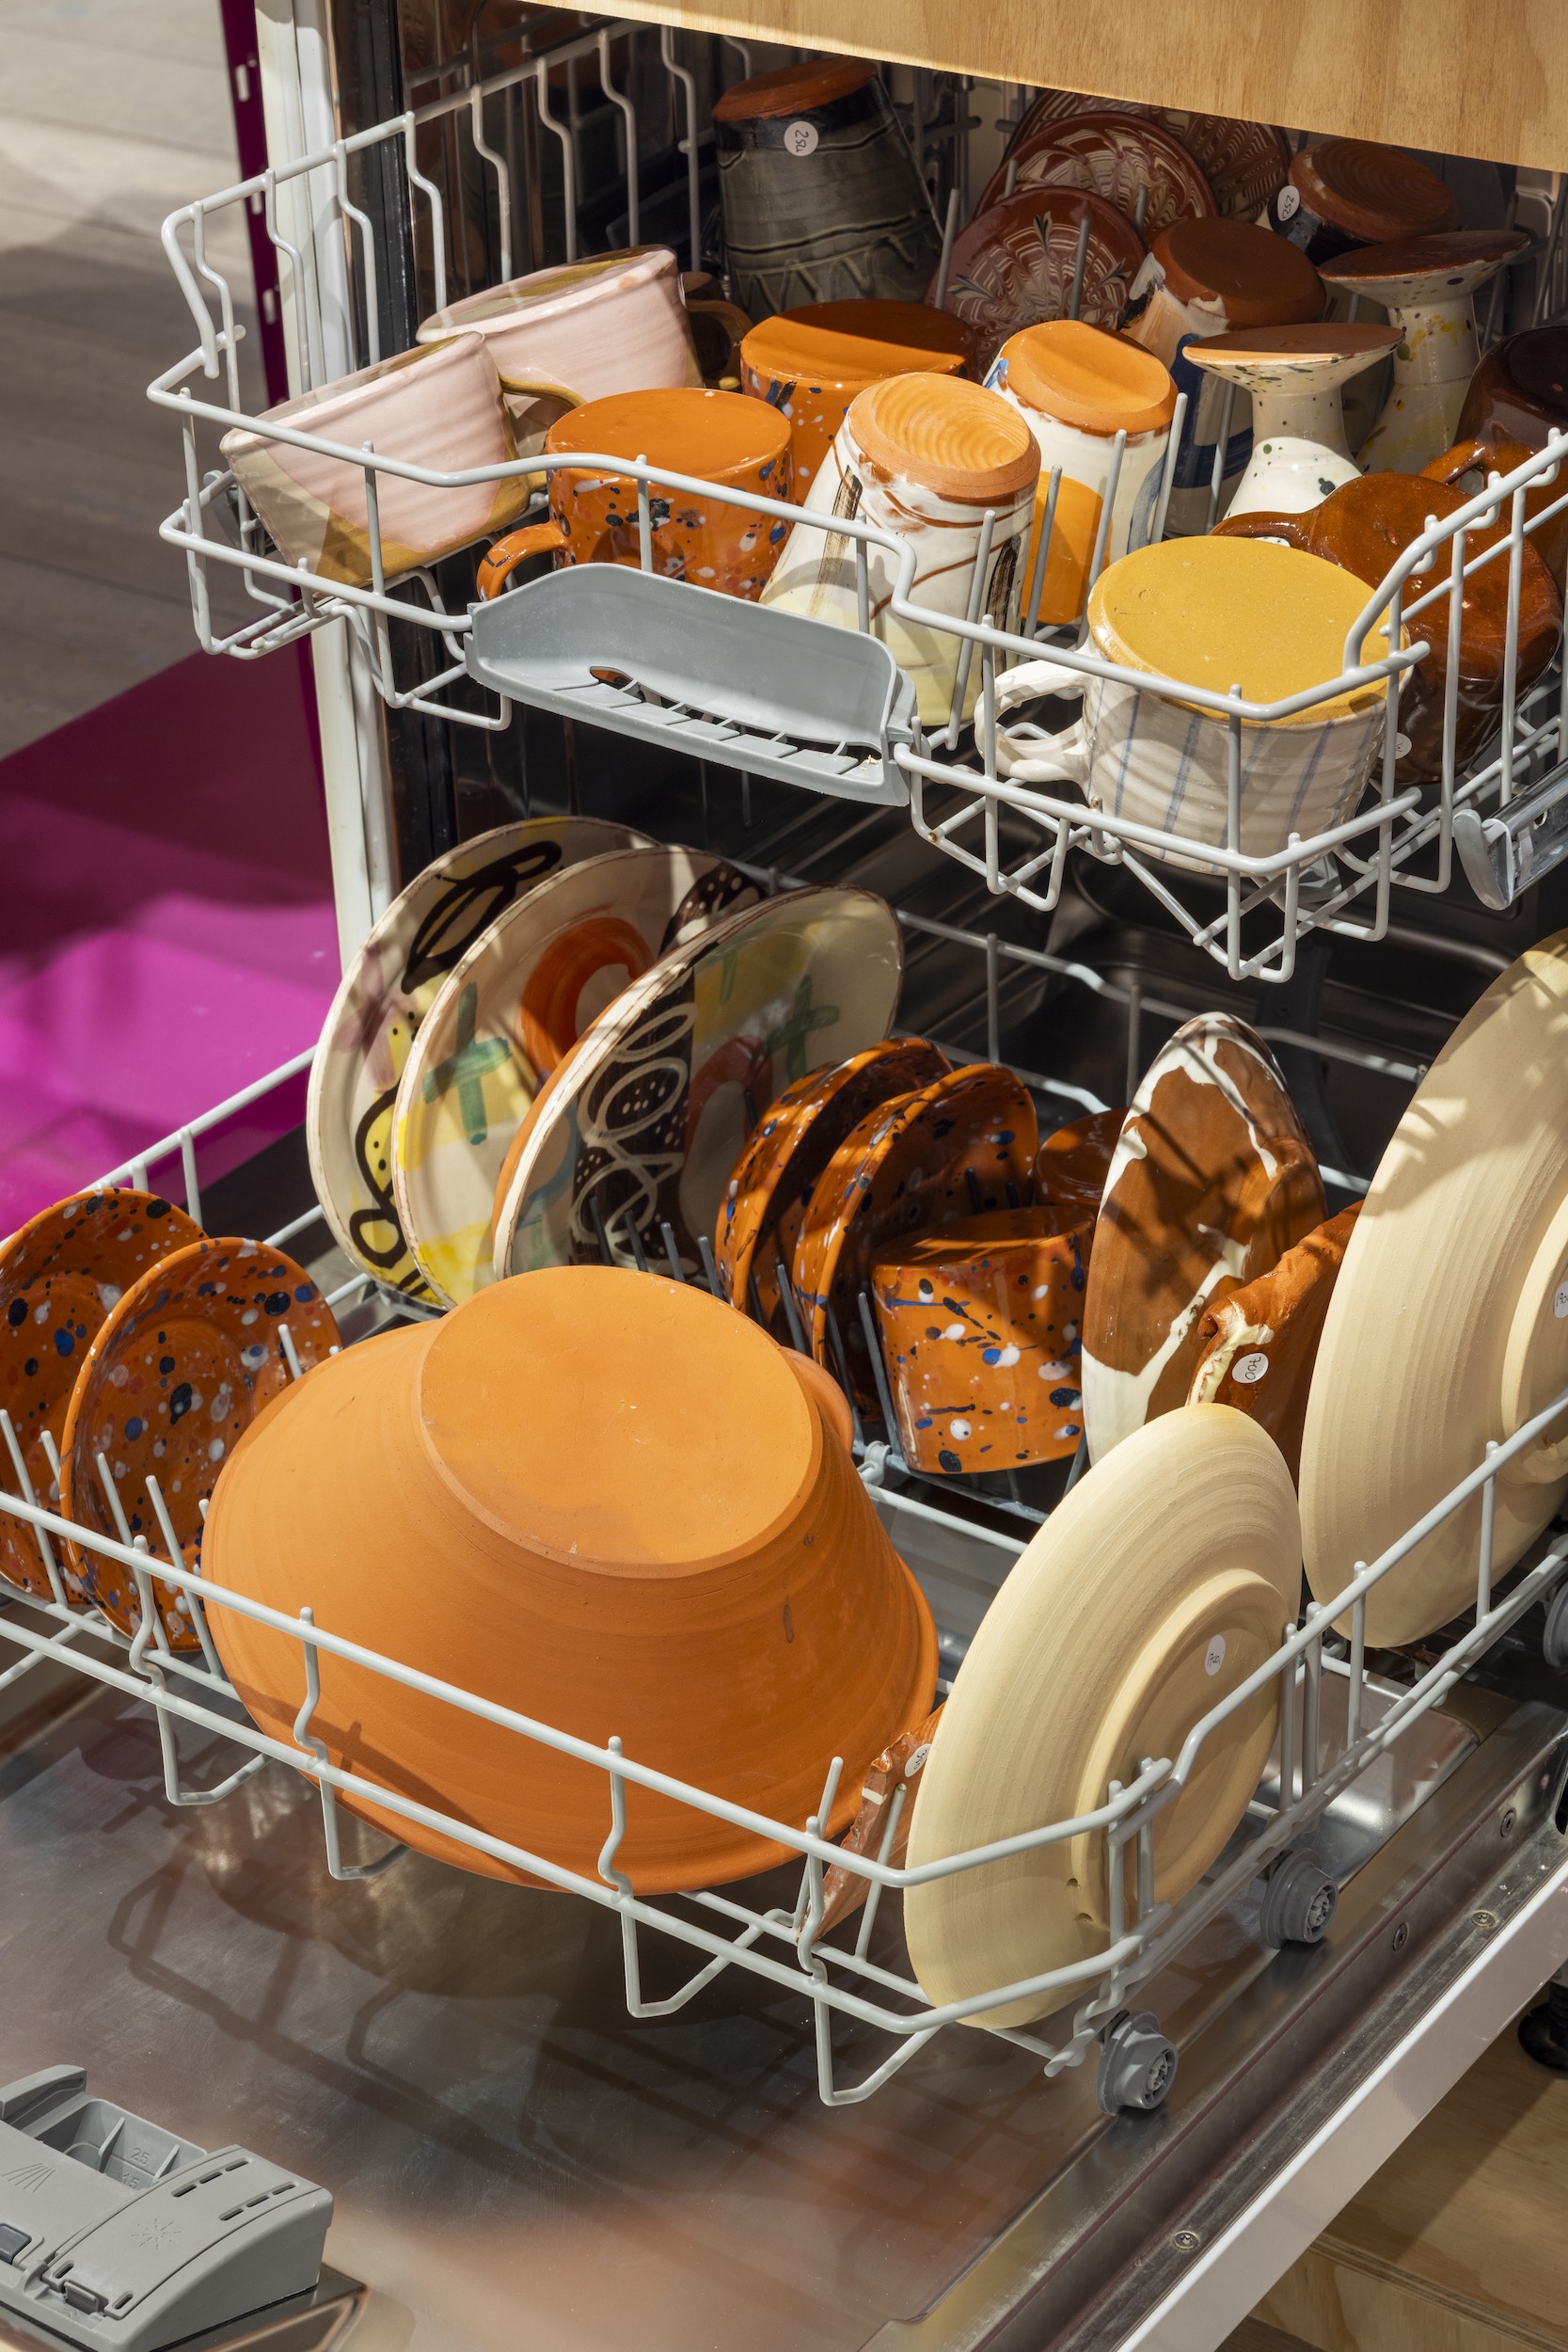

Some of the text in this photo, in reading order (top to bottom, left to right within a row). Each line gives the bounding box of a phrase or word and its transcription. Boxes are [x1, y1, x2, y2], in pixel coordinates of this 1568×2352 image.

[1244, 1356, 1261, 1380] 700
[130, 2147, 150, 2165] 25
[122, 2173, 140, 2189] 15
